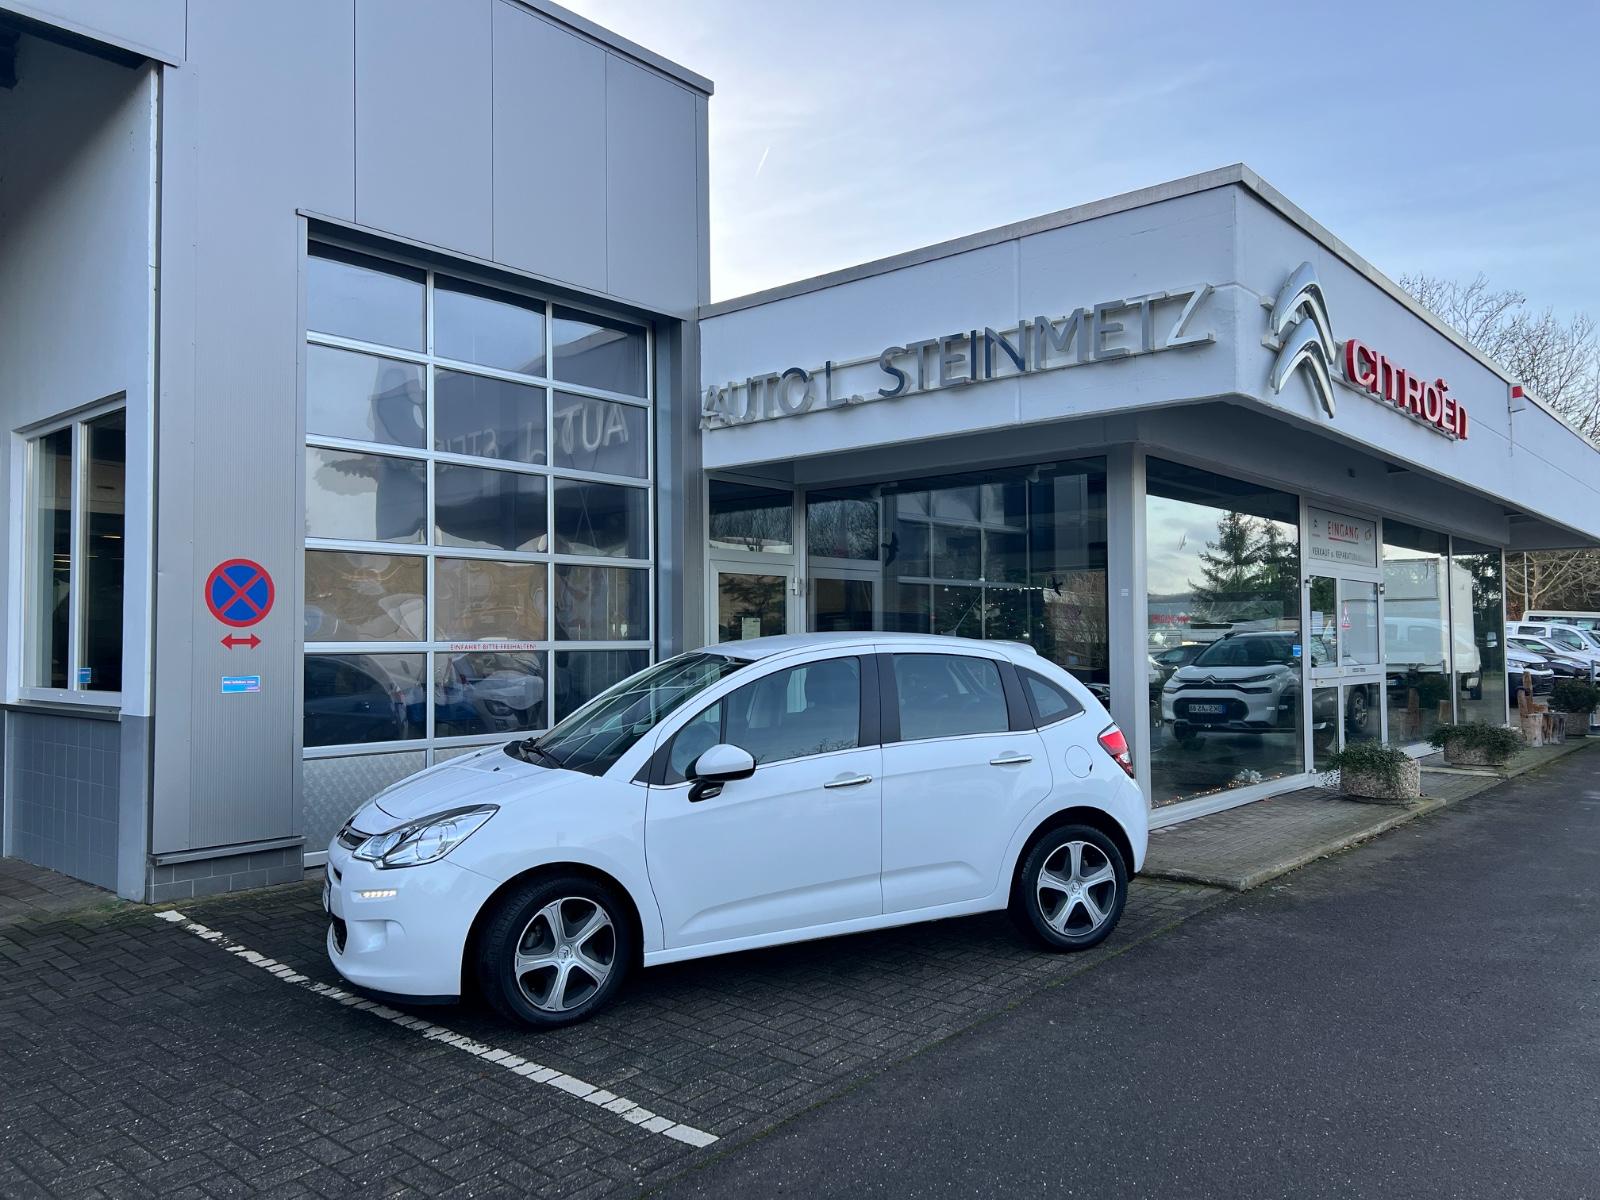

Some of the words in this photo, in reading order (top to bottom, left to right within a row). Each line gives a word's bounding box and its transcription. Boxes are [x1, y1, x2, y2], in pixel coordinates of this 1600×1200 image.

[700, 367, 814, 430] AUTO
[878, 283, 1216, 397] STEINMETZ
[1327, 520, 1359, 541] EINGANG
[1312, 547, 1330, 558] VERKAUF
[450, 641, 480, 651] EINFAHRT
[482, 641, 499, 650] BITTE
